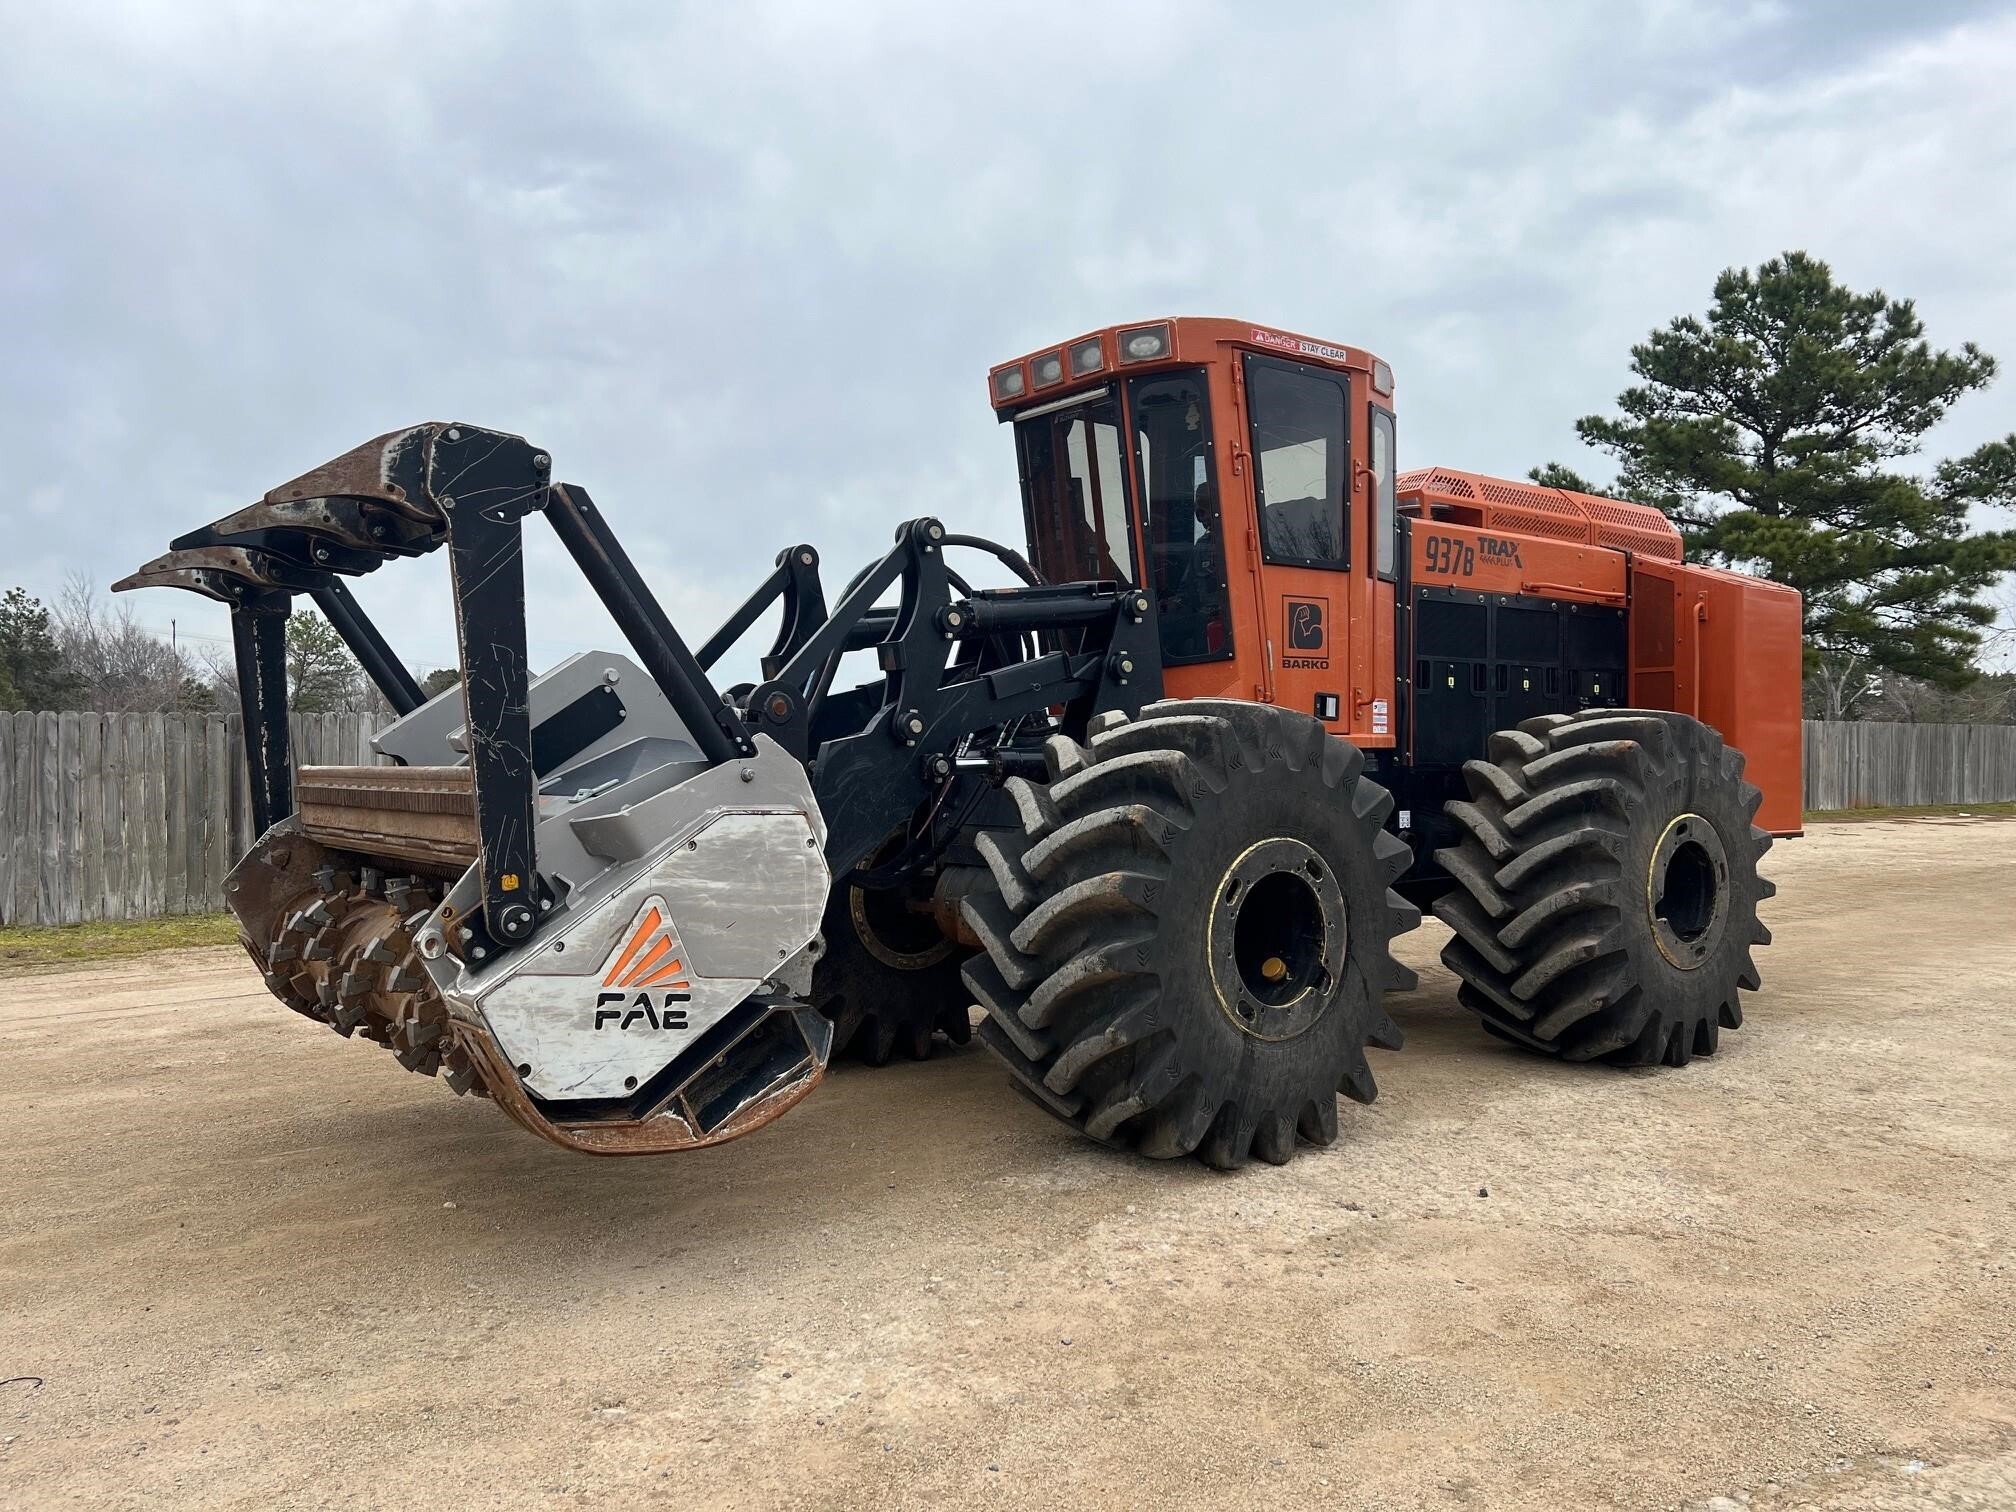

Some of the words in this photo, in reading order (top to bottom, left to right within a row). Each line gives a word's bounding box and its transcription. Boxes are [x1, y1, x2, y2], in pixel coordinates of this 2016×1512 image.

[1264, 333, 1296, 349] DANGER
[1301, 343, 1321, 354] STAY
[1320, 347, 1345, 360] CLEAR
[1425, 535, 1475, 576] 937B
[1477, 536, 1522, 568] TRAX
[1282, 659, 1329, 670] BARKO
[595, 992, 691, 1030] FAE
